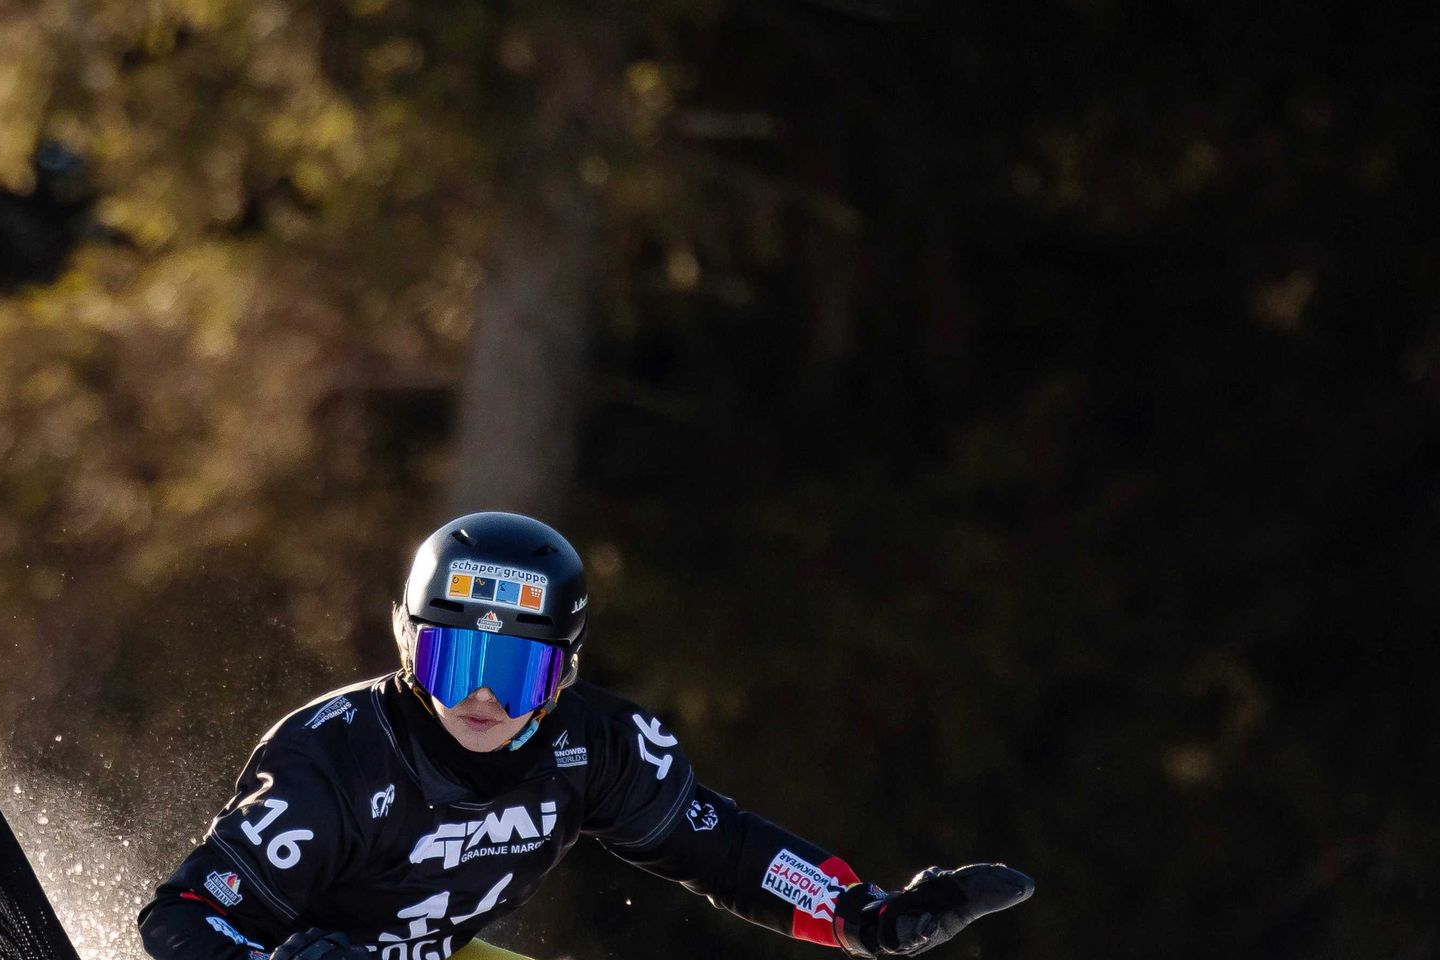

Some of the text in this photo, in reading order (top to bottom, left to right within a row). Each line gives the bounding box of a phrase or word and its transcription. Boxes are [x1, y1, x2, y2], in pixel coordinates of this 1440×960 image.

[451, 560, 547, 584] schaper gruppe
[241, 798, 314, 870] 16
[461, 834, 552, 863] GRADNJE MARG
[770, 863, 822, 896] MODYF
[779, 852, 829, 886] WORKWEAR
[205, 880, 232, 906] GERMANY
[764, 873, 813, 910] WÜRTH
